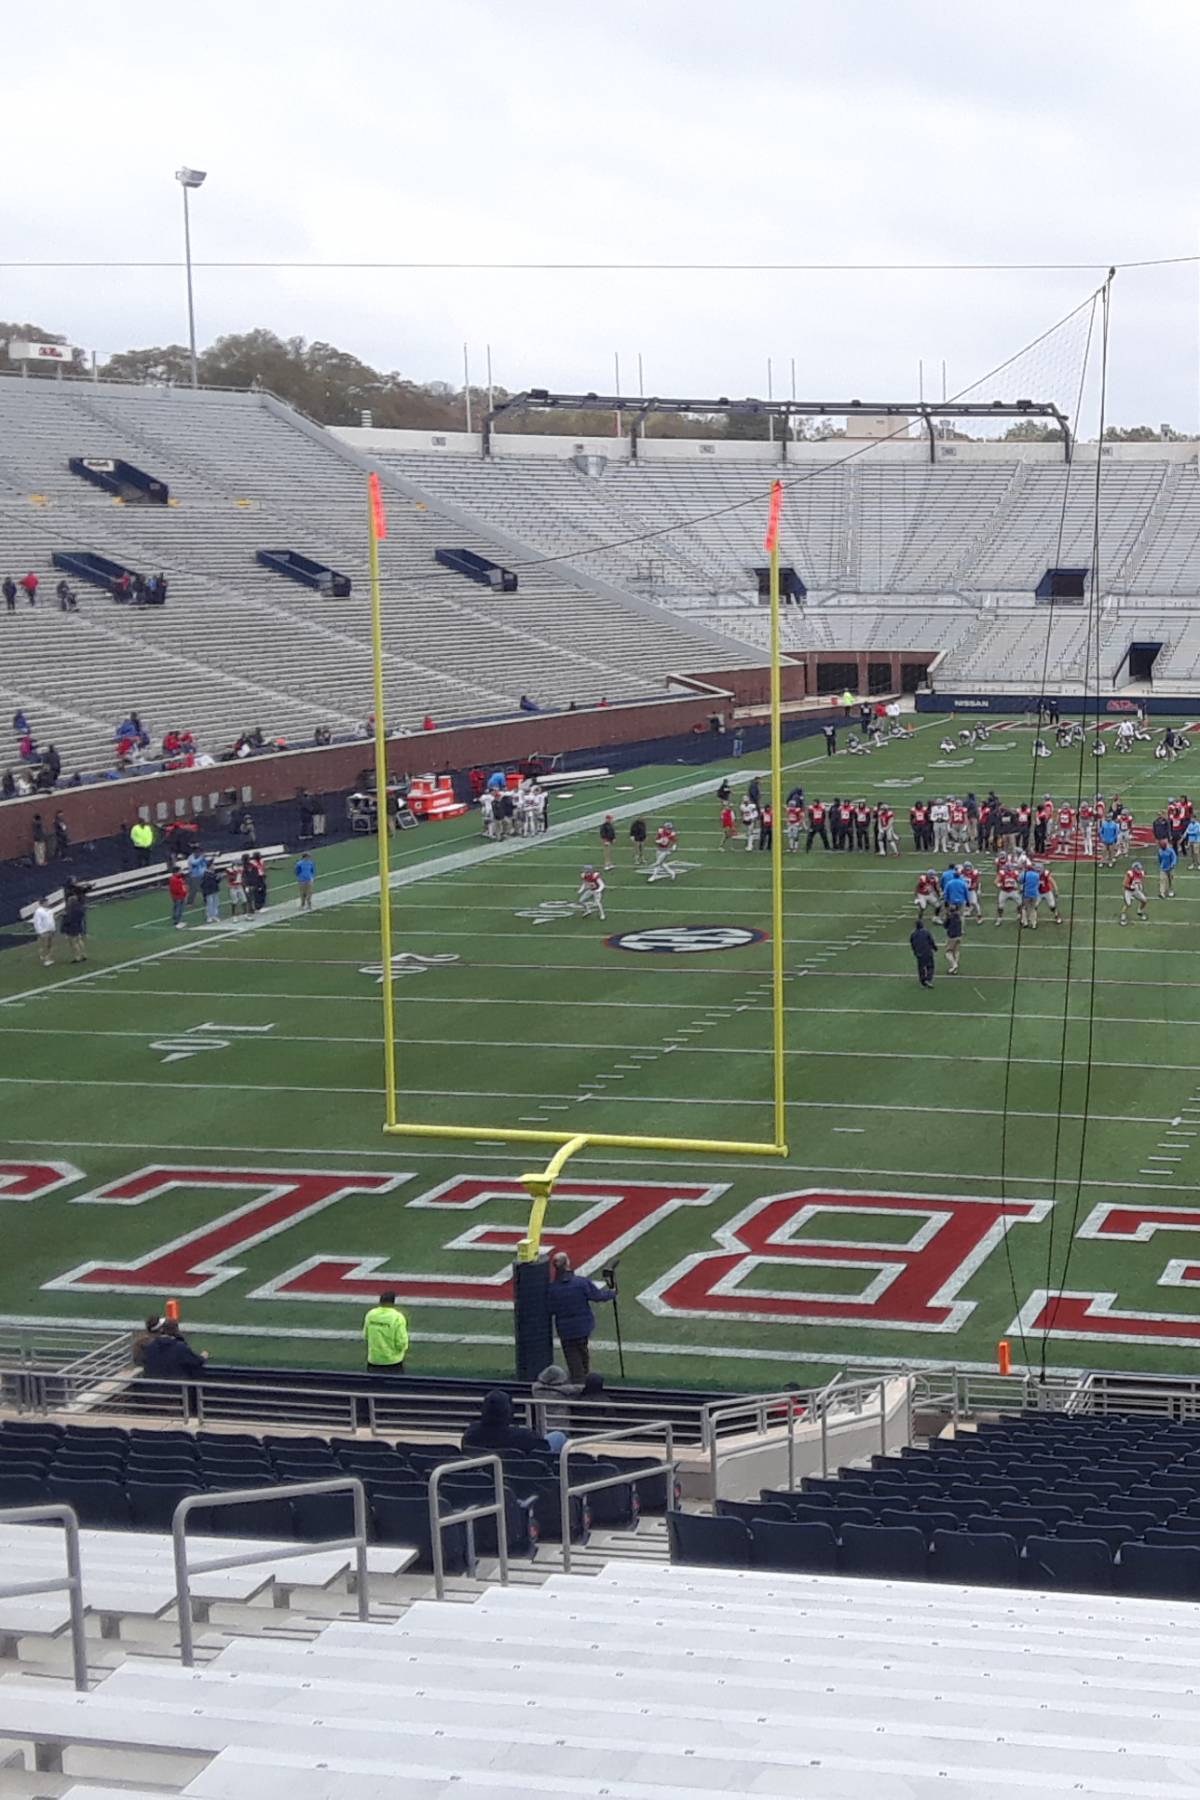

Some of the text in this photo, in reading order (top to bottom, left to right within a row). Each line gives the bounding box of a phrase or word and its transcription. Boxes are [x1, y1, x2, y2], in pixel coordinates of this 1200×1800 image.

[954, 700, 989, 708] NISSAN
[357, 951, 461, 978] 20
[148, 1020, 278, 1055] 10
